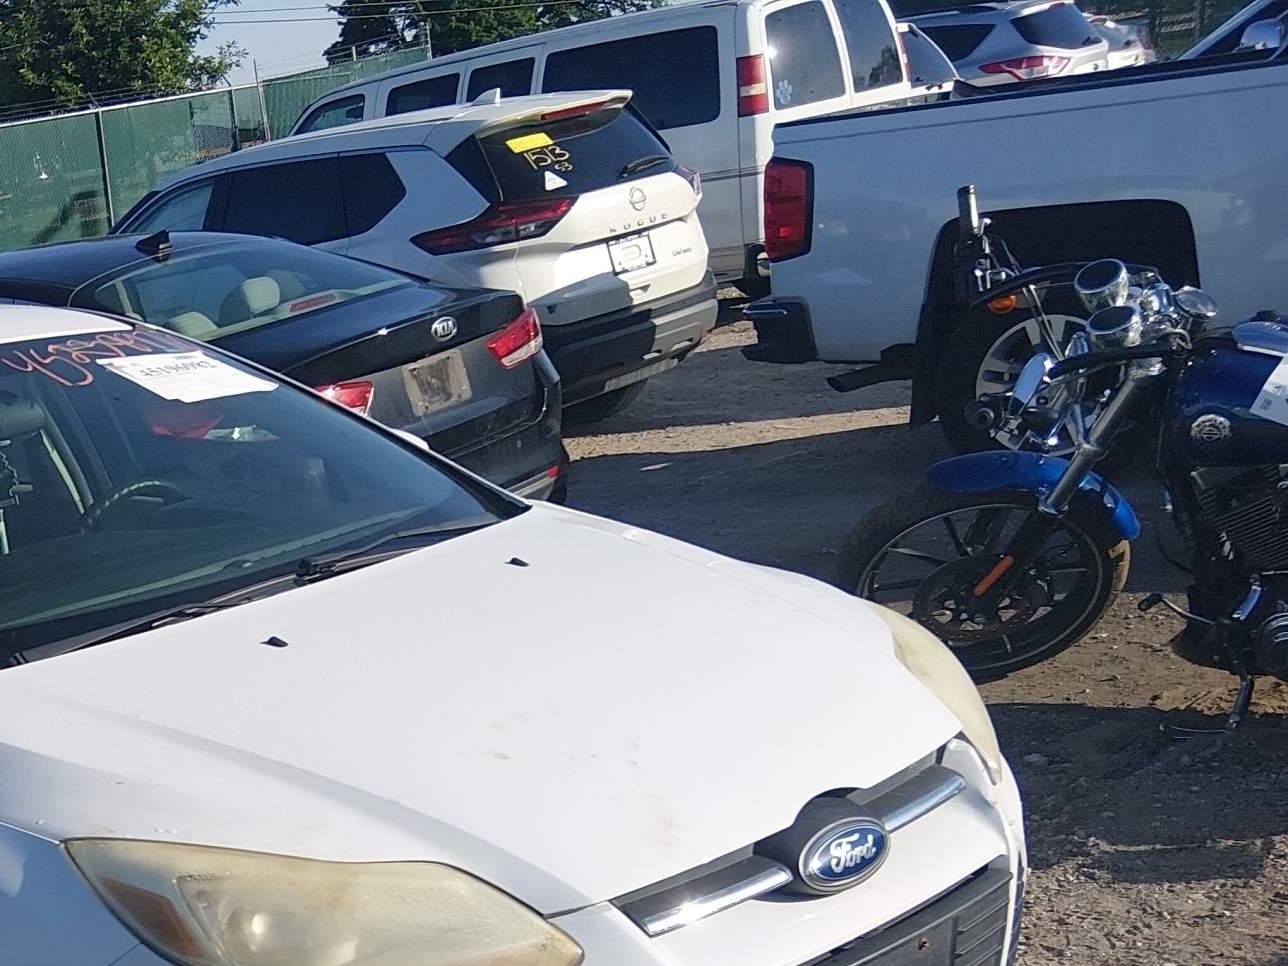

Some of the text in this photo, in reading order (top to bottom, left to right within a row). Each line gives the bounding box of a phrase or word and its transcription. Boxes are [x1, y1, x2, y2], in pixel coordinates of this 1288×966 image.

[609, 213, 668, 234] ROGUE
[432, 320, 455, 338] KIA
[829, 832, 877, 873] Ford
